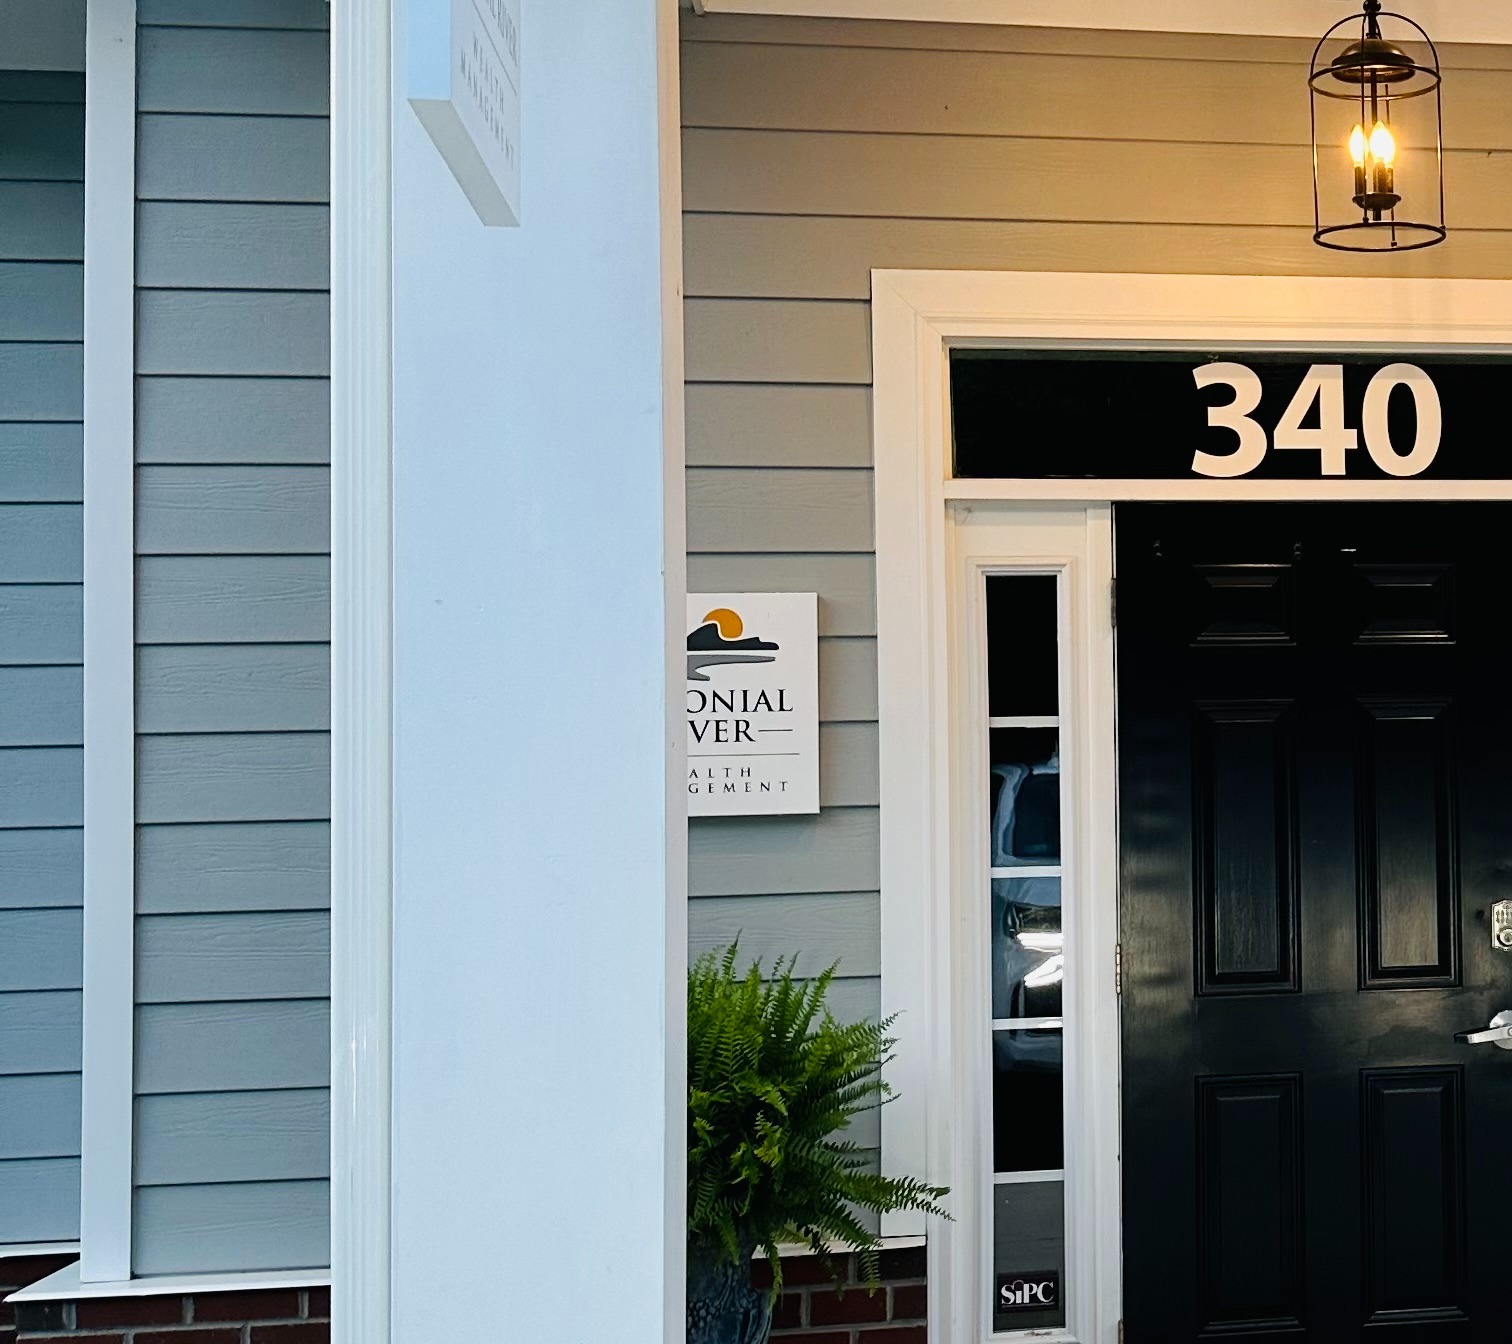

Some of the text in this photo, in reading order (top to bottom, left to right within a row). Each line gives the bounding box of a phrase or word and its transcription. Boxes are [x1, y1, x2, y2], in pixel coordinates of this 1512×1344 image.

[473, 33, 504, 114] WEALTH
[460, 49, 514, 169] MANAGEMENT
[1191, 362, 1442, 478] 340
[687, 689, 794, 714] ONIAL
[687, 719, 756, 744] VER
[688, 767, 752, 779] ALTH
[688, 781, 788, 794] GEMENT
